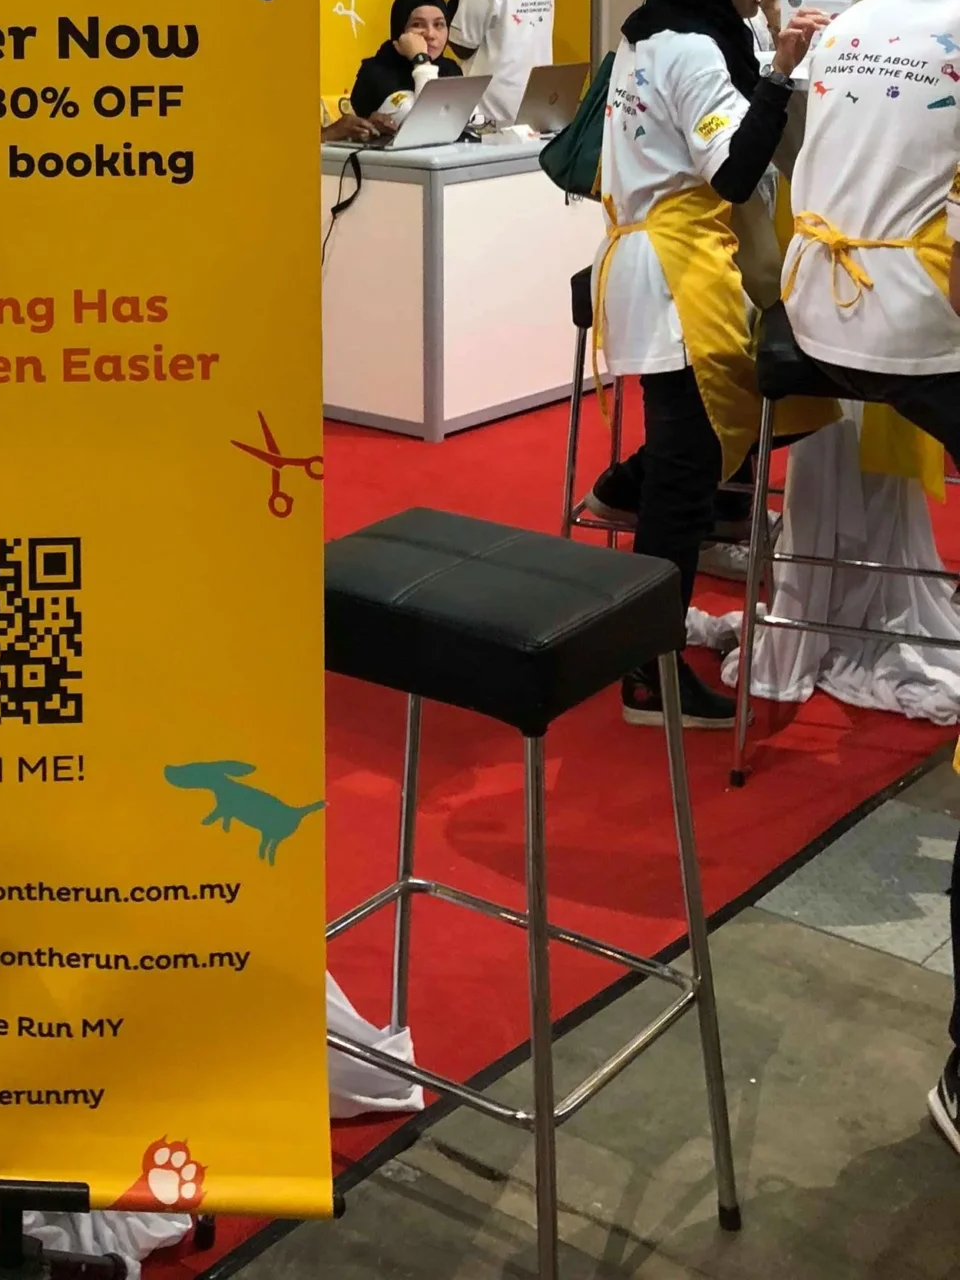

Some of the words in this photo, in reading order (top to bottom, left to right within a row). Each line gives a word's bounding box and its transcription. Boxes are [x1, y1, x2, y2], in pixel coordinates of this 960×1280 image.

[57, 16, 200, 60] Now
[825, 66, 854, 74] PAWS
[857, 66, 875, 74] ON
[877, 67, 902, 78] THE
[904, 72, 940, 87] RUN!
[838, 53, 860, 61] ASK
[863, 54, 881, 63] ME
[883, 56, 928, 69] ABOUT
[93, 85, 184, 118] OFF
[8, 141, 194, 185] booking
[73, 289, 168, 324] Has
[62, 344, 219, 382] Easier
[18, 754, 85, 782] ME!
[17, 1016, 74, 1039] Run
[81, 1018, 125, 1038] MY
